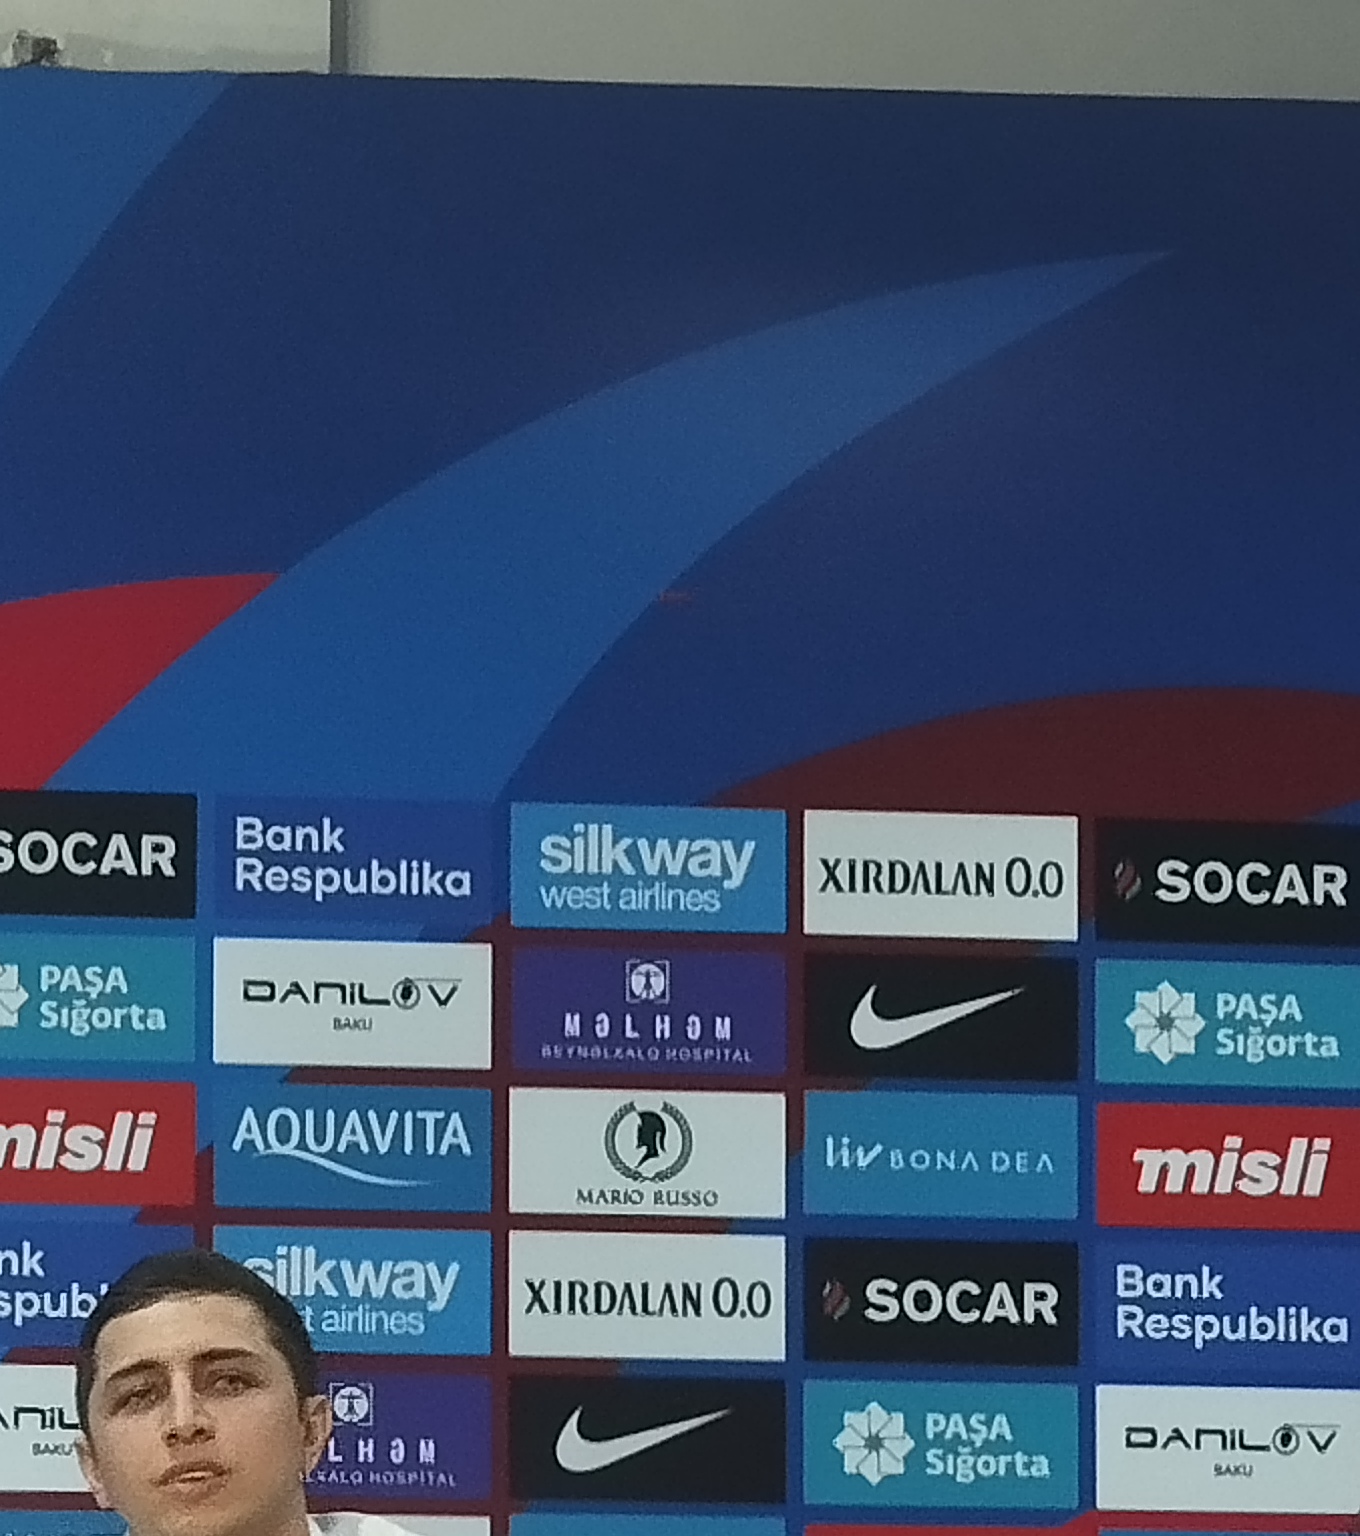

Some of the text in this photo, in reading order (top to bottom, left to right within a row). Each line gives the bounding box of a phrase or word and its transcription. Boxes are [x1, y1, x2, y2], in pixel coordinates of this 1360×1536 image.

[235, 816, 346, 854] Bank
[235, 856, 472, 902] Respublika
[819, 856, 1064, 899] XIRDALAN 0.0
[1154, 859, 1347, 907] SOCAR
[541, 881, 722, 913] west airlines
[40, 964, 128, 998] PAŞA
[332, 1016, 374, 1032] BAKU
[1217, 993, 1302, 1026] PAŞA
[233, 1107, 472, 1158] AQUAVITA
[889, 1149, 980, 1172] BONA
[991, 1150, 1055, 1175] DEA
[1133, 1137, 1332, 1198] misli
[576, 1187, 719, 1208] MARIO RUSSO
[524, 1277, 772, 1320] XIRDALAN 0.0
[1116, 1264, 1224, 1301] Bank
[321, 1304, 426, 1334] airlines
[864, 1280, 1060, 1326] SOCAR
[1116, 1304, 1349, 1349] Respublika
[926, 1413, 1013, 1445] PAŞA
[32, 1443, 74, 1456] BAKU
[326, 1437, 436, 1465] LHƏM
[1213, 1462, 1254, 1477] BAKU
